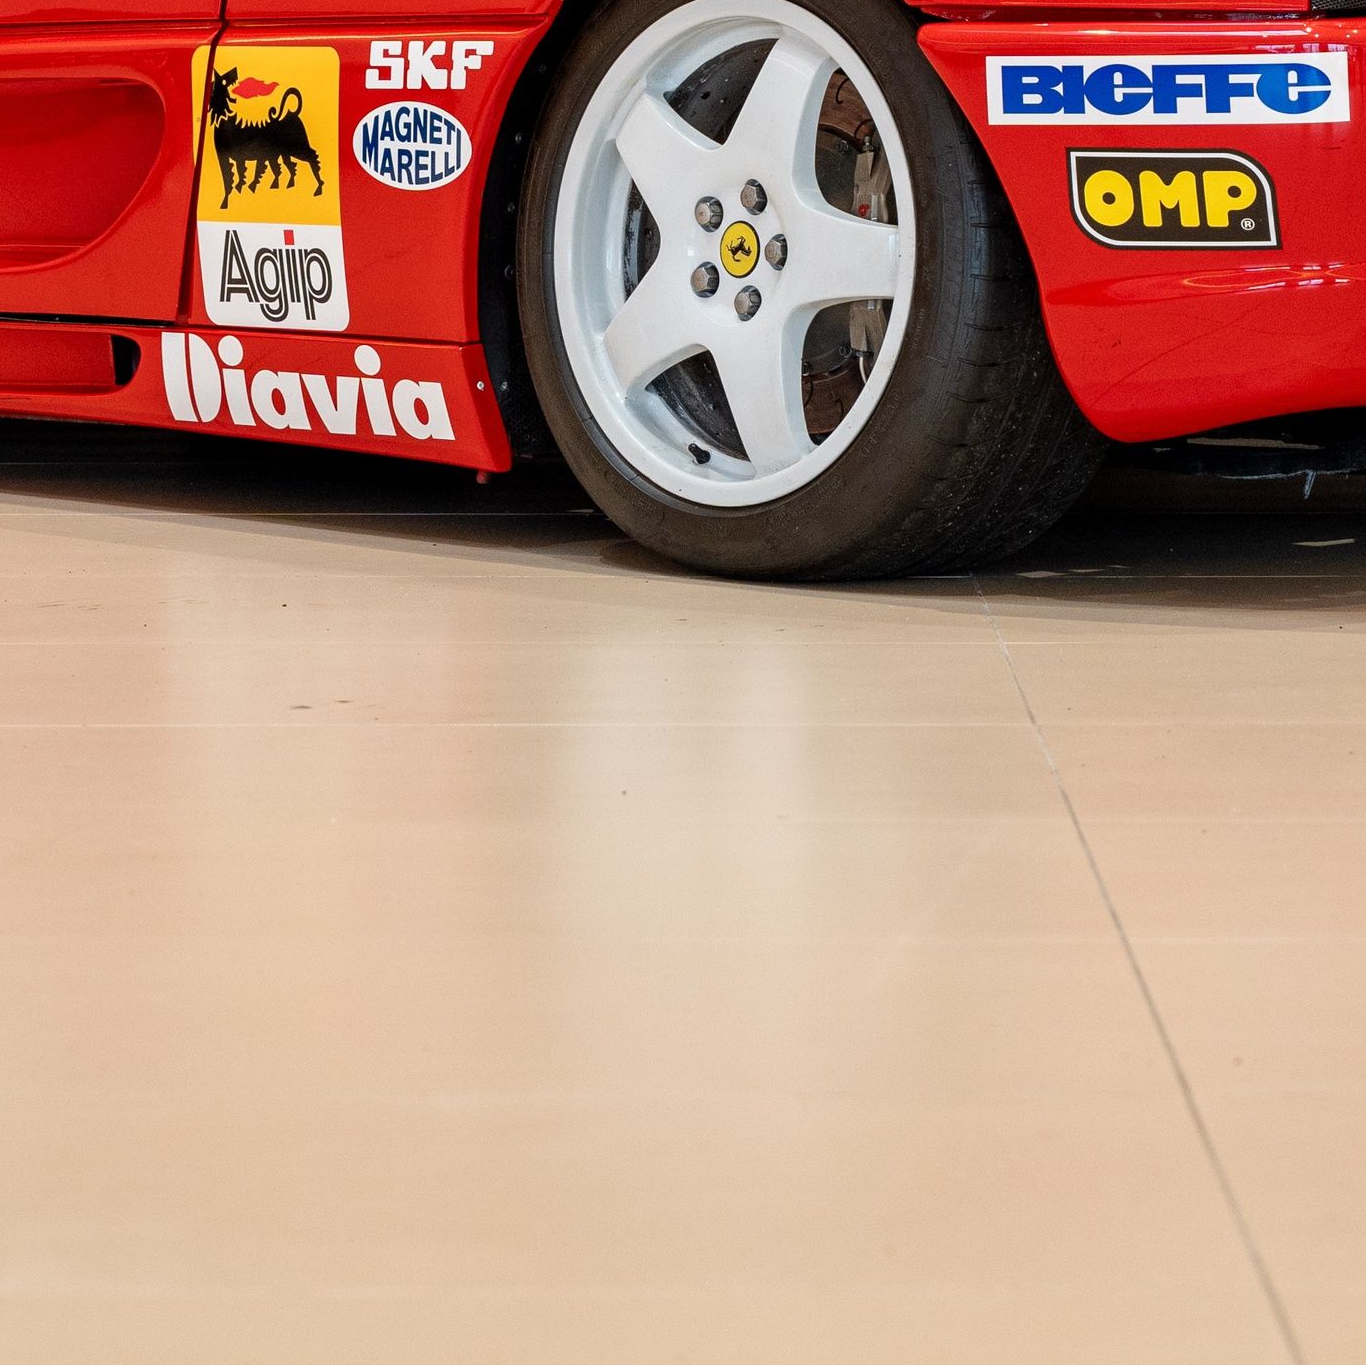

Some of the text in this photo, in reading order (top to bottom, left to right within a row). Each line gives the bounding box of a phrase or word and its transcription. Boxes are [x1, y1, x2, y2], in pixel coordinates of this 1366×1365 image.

[365, 40, 495, 90] SKF
[362, 106, 462, 151] MAGNETI
[362, 141, 462, 186] MARELLI
[1083, 169, 1258, 228] OMP
[219, 229, 333, 323] Agip
[160, 331, 457, 442] Diavia
